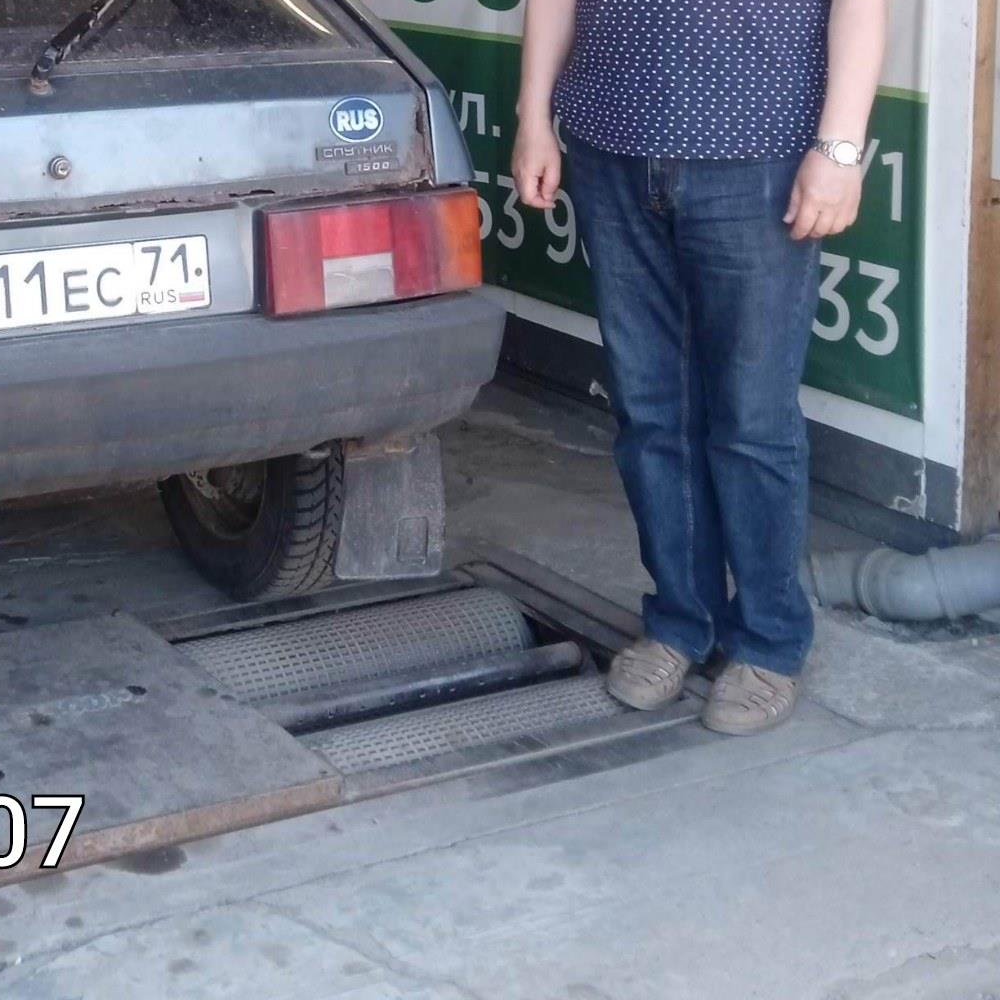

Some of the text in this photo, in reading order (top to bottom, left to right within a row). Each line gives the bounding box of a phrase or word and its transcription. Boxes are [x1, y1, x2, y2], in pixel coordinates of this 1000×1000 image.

[336, 109, 379, 132] RUS
[357, 161, 390, 172] 1500
[141, 243, 189, 286] 71
[140, 289, 177, 306] RUS
